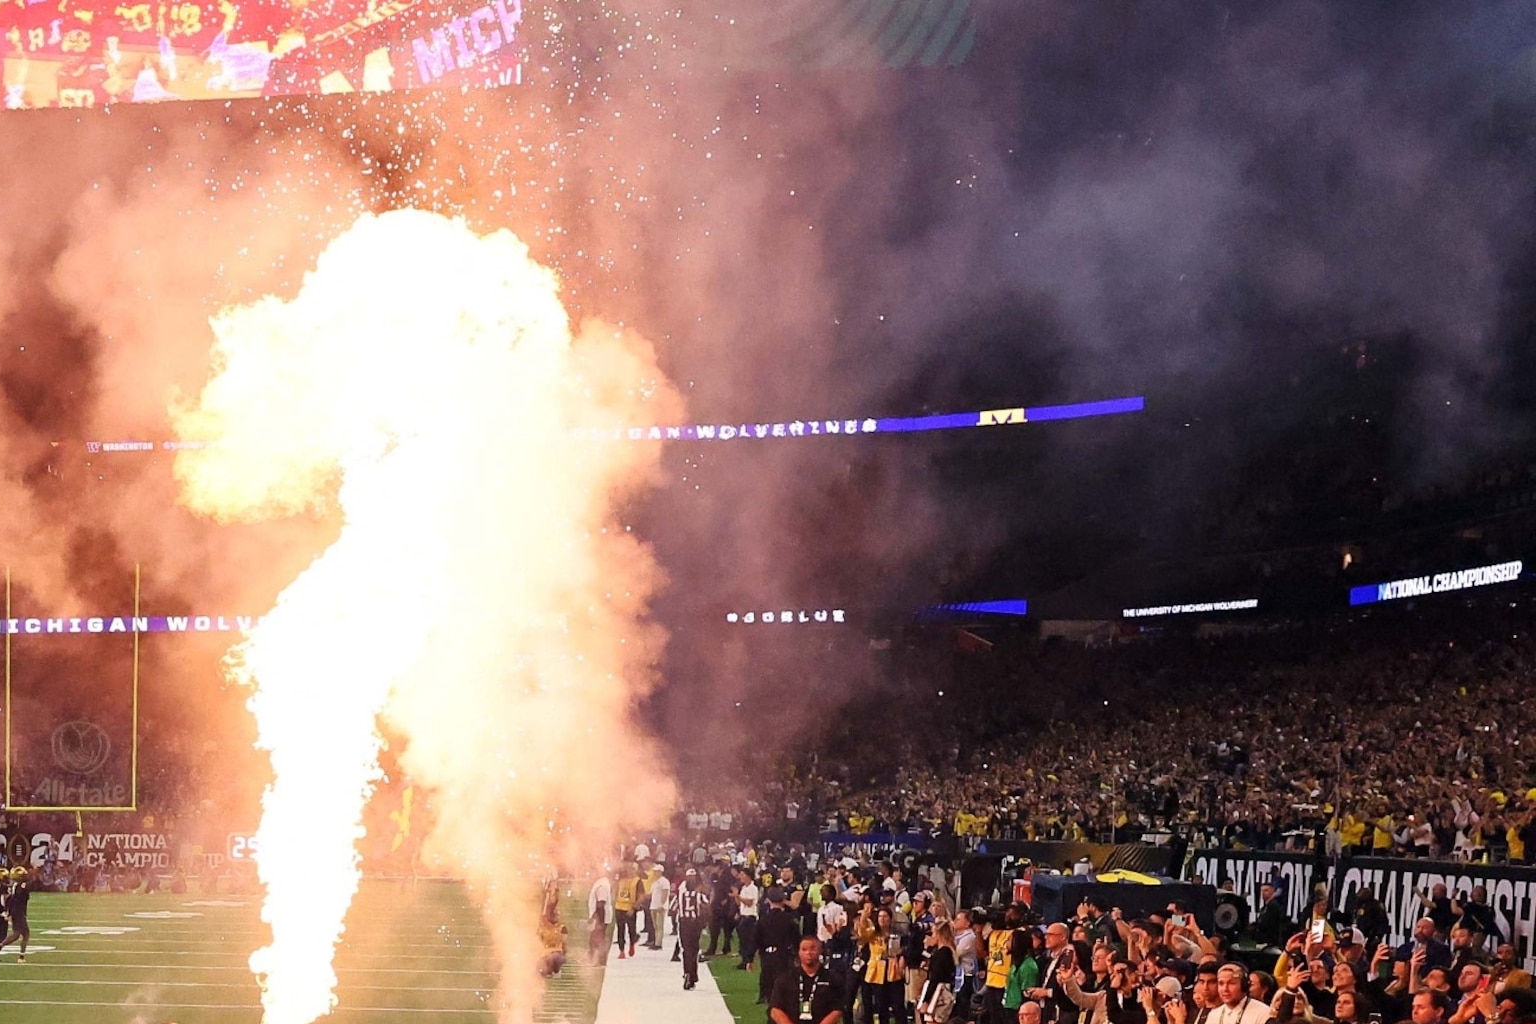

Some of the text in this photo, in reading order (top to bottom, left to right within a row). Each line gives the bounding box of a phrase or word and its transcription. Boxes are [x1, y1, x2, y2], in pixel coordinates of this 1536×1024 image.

[1378, 561, 1523, 600] NATIONAL CHAMPIONSHIP
[87, 833, 173, 850] NATIONA
